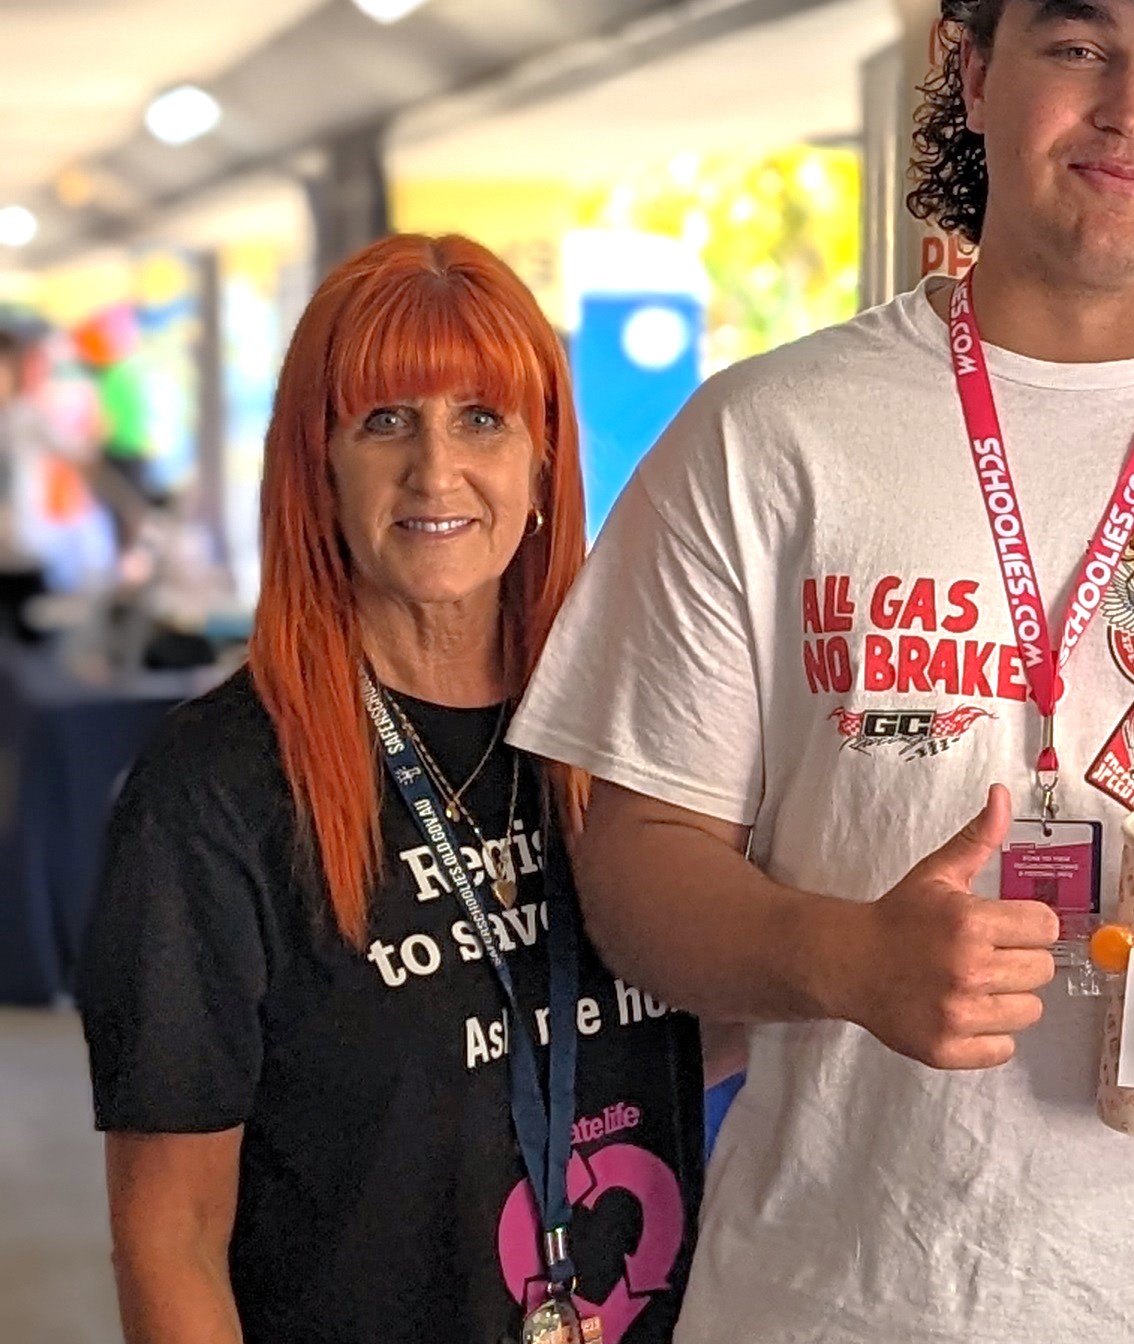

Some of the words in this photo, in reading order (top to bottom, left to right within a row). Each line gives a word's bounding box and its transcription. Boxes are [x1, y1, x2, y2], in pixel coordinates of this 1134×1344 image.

[973, 436, 1044, 670] SCHOOLIES.COM
[802, 574, 856, 634] ALL
[869, 574, 980, 634] GAS
[803, 634, 852, 694] NO
[863, 712, 933, 737] GC
[367, 933, 442, 988] to
